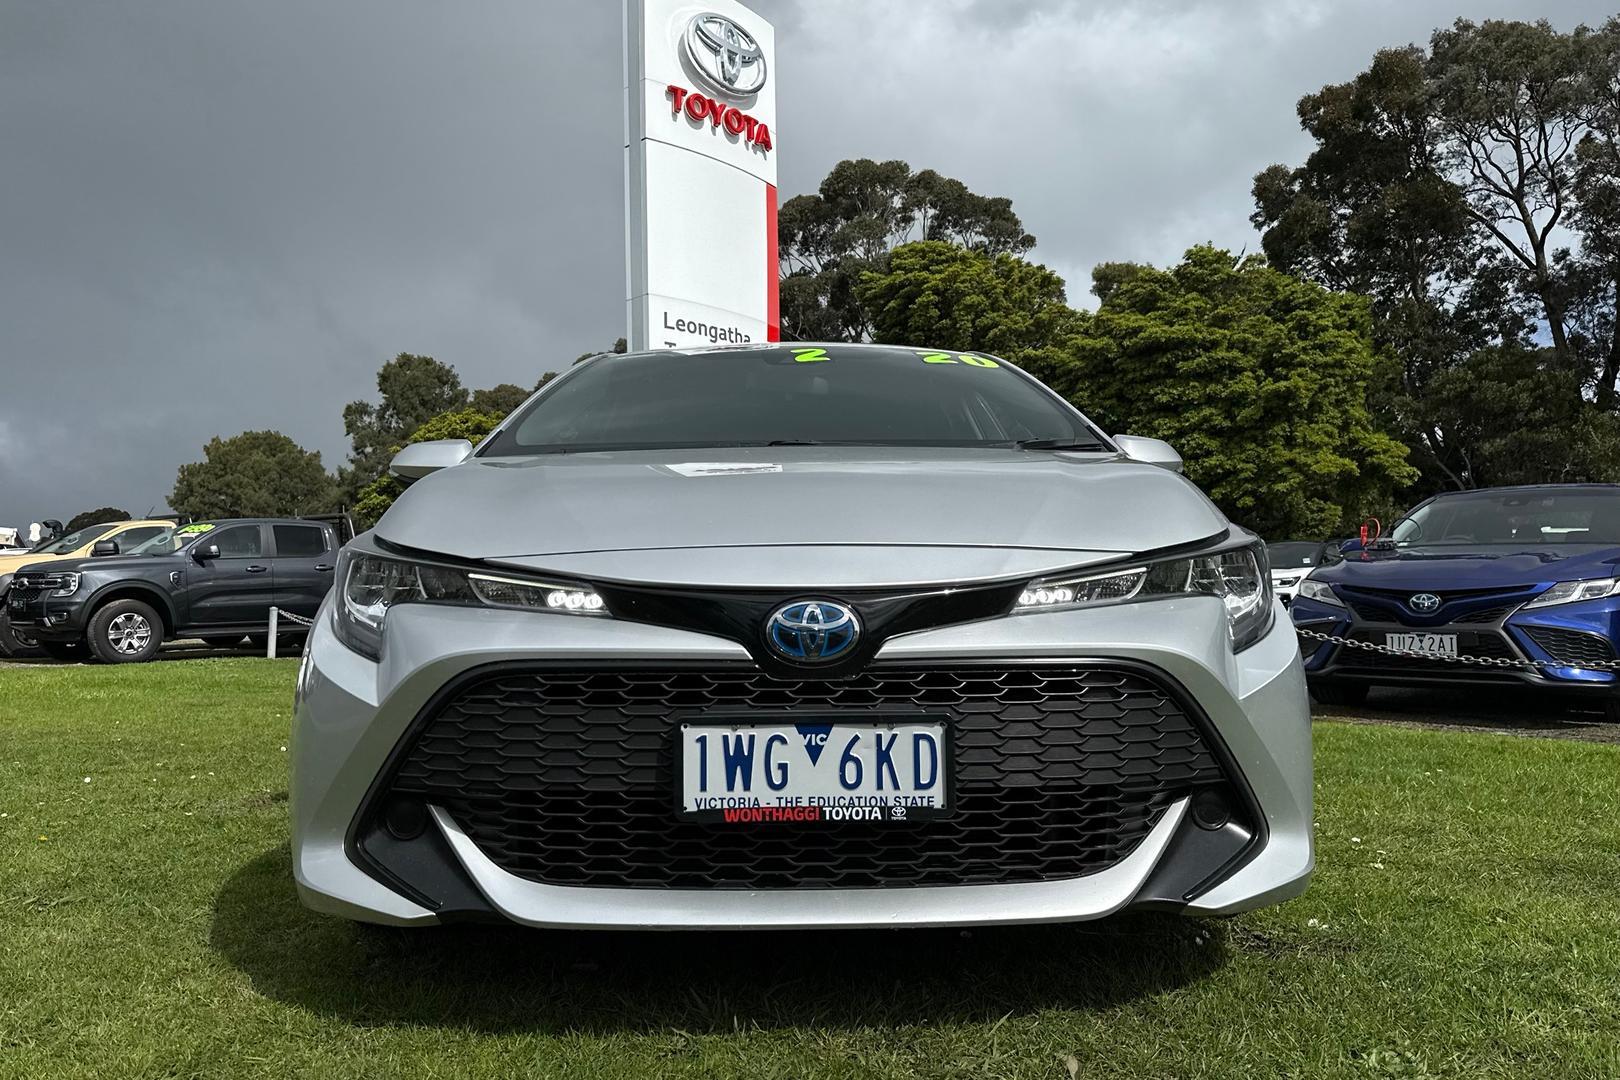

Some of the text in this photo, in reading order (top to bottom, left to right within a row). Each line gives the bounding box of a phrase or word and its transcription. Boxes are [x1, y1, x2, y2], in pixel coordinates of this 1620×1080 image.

[667, 85, 772, 152] TOYOTA
[664, 312, 751, 343] Leongatha
[801, 733, 828, 746] VIC
[695, 732, 938, 792] 1WG 6KD
[695, 797, 760, 810] VICTORIA
[776, 797, 802, 808] THE
[808, 796, 888, 807] EDUCATION
[893, 796, 935, 808] STATE
[724, 806, 882, 822] WONTHAGGI TOYOTA
